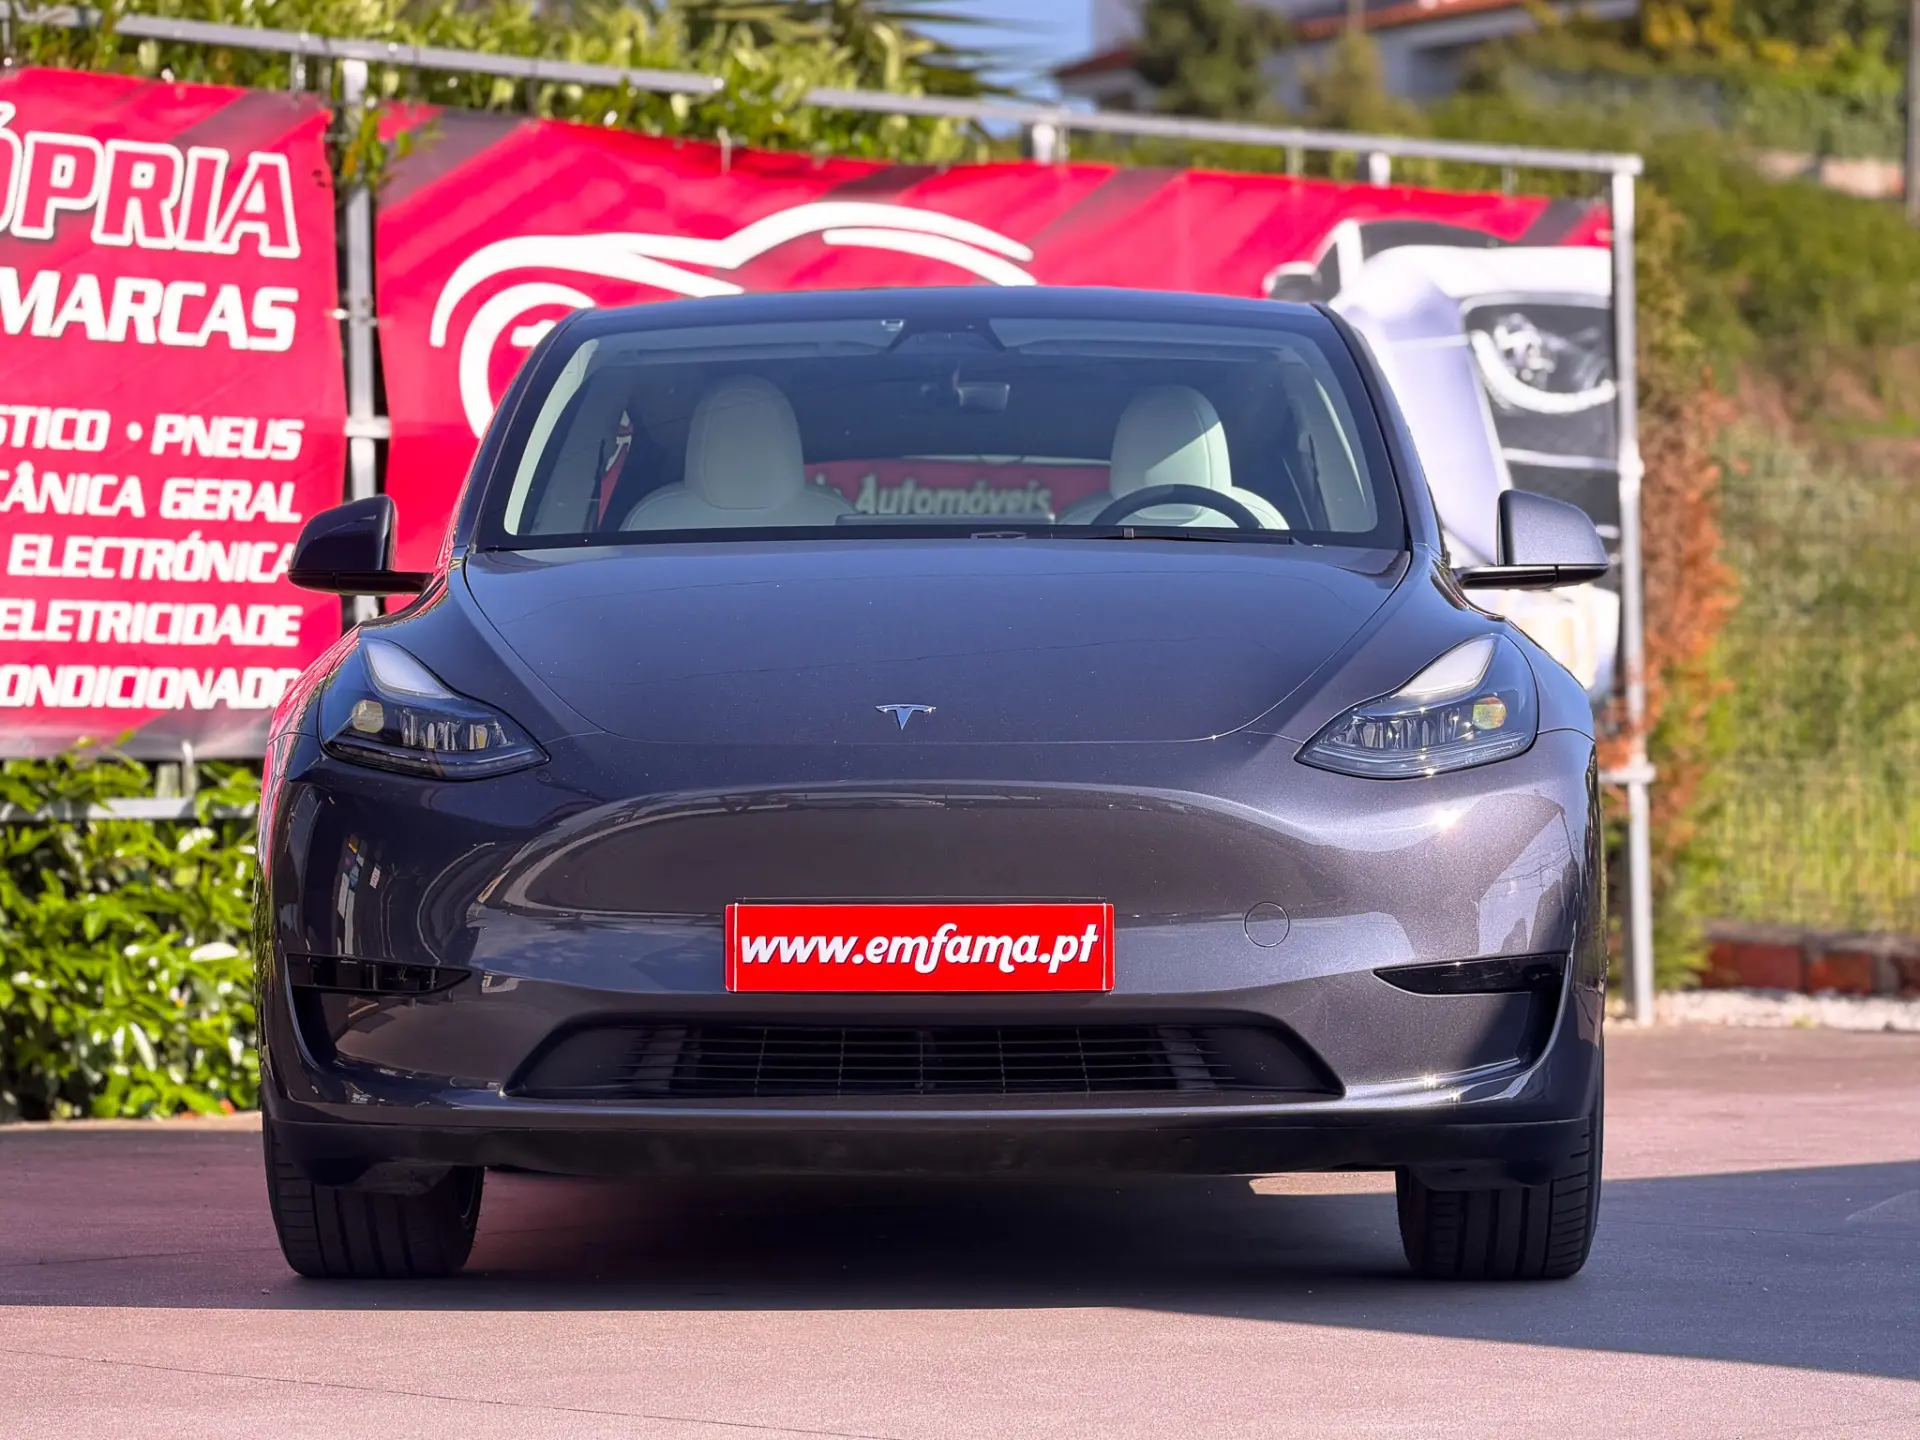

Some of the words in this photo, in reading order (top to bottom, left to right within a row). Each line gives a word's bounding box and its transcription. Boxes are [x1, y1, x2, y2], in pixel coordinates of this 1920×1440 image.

[0, 100, 301, 259] PRIA
[0, 266, 299, 352] MARCAS
[150, 413, 305, 461] PNEUS
[0, 460, 146, 518] ÂNICA
[159, 477, 302, 523] GERAL
[0, 598, 304, 646] ELETRICIDADE
[740, 923, 1099, 974] www.emfama.pt
